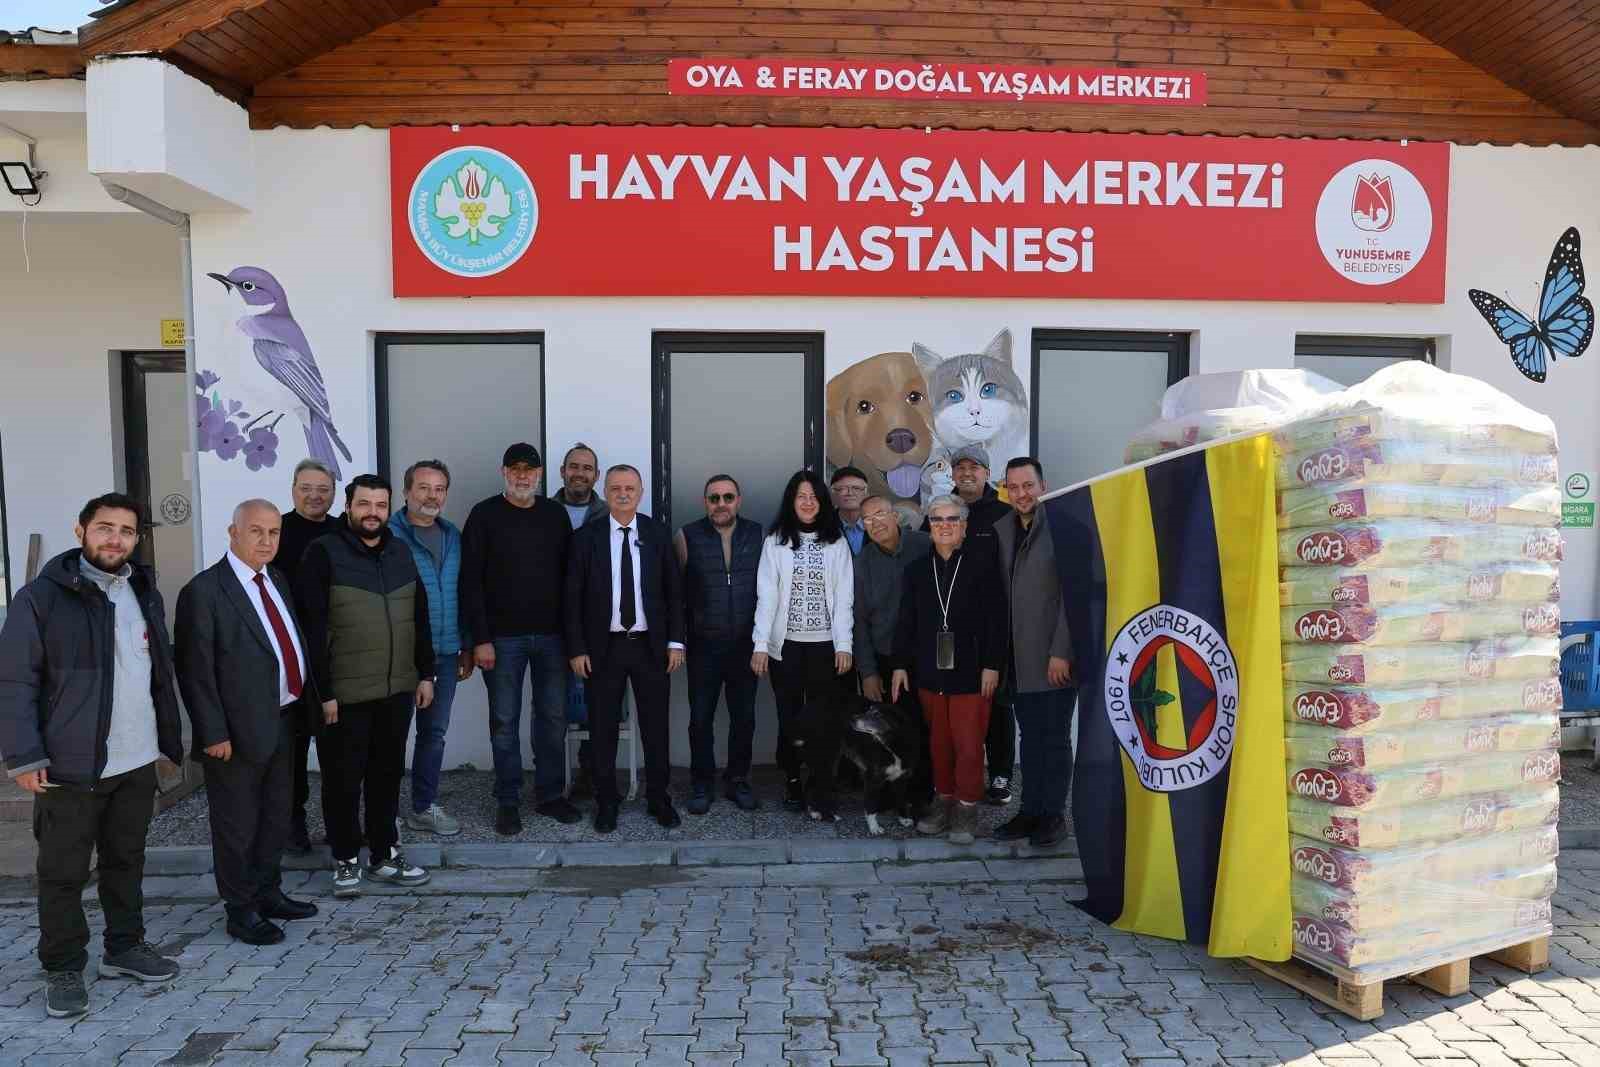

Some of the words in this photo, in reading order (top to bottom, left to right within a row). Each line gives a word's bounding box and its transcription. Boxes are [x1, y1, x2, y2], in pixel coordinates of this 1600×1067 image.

[686, 66, 743, 88] OYA
[755, 67, 777, 89] &
[783, 67, 868, 90] FERAY
[874, 64, 972, 94] DOĞAL
[977, 71, 1070, 101] YAŞAM
[569, 153, 807, 202] HAYVAN
[822, 156, 1026, 216] YAŞAM
[1336, 249, 1411, 261] YUNUSEMRE
[1302, 454, 1344, 482] Enjoy
[1302, 536, 1344, 562] Enjoy
[1300, 614, 1341, 640] Enjoy
[1108, 675, 1131, 723] 1907
[1128, 610, 1234, 683] FENERBAHÇE
[1209, 695, 1236, 760] SPOR
[1297, 695, 1339, 723] Enjoy
[1296, 772, 1338, 800] Enjoy
[1295, 851, 1336, 882] Enjoy
